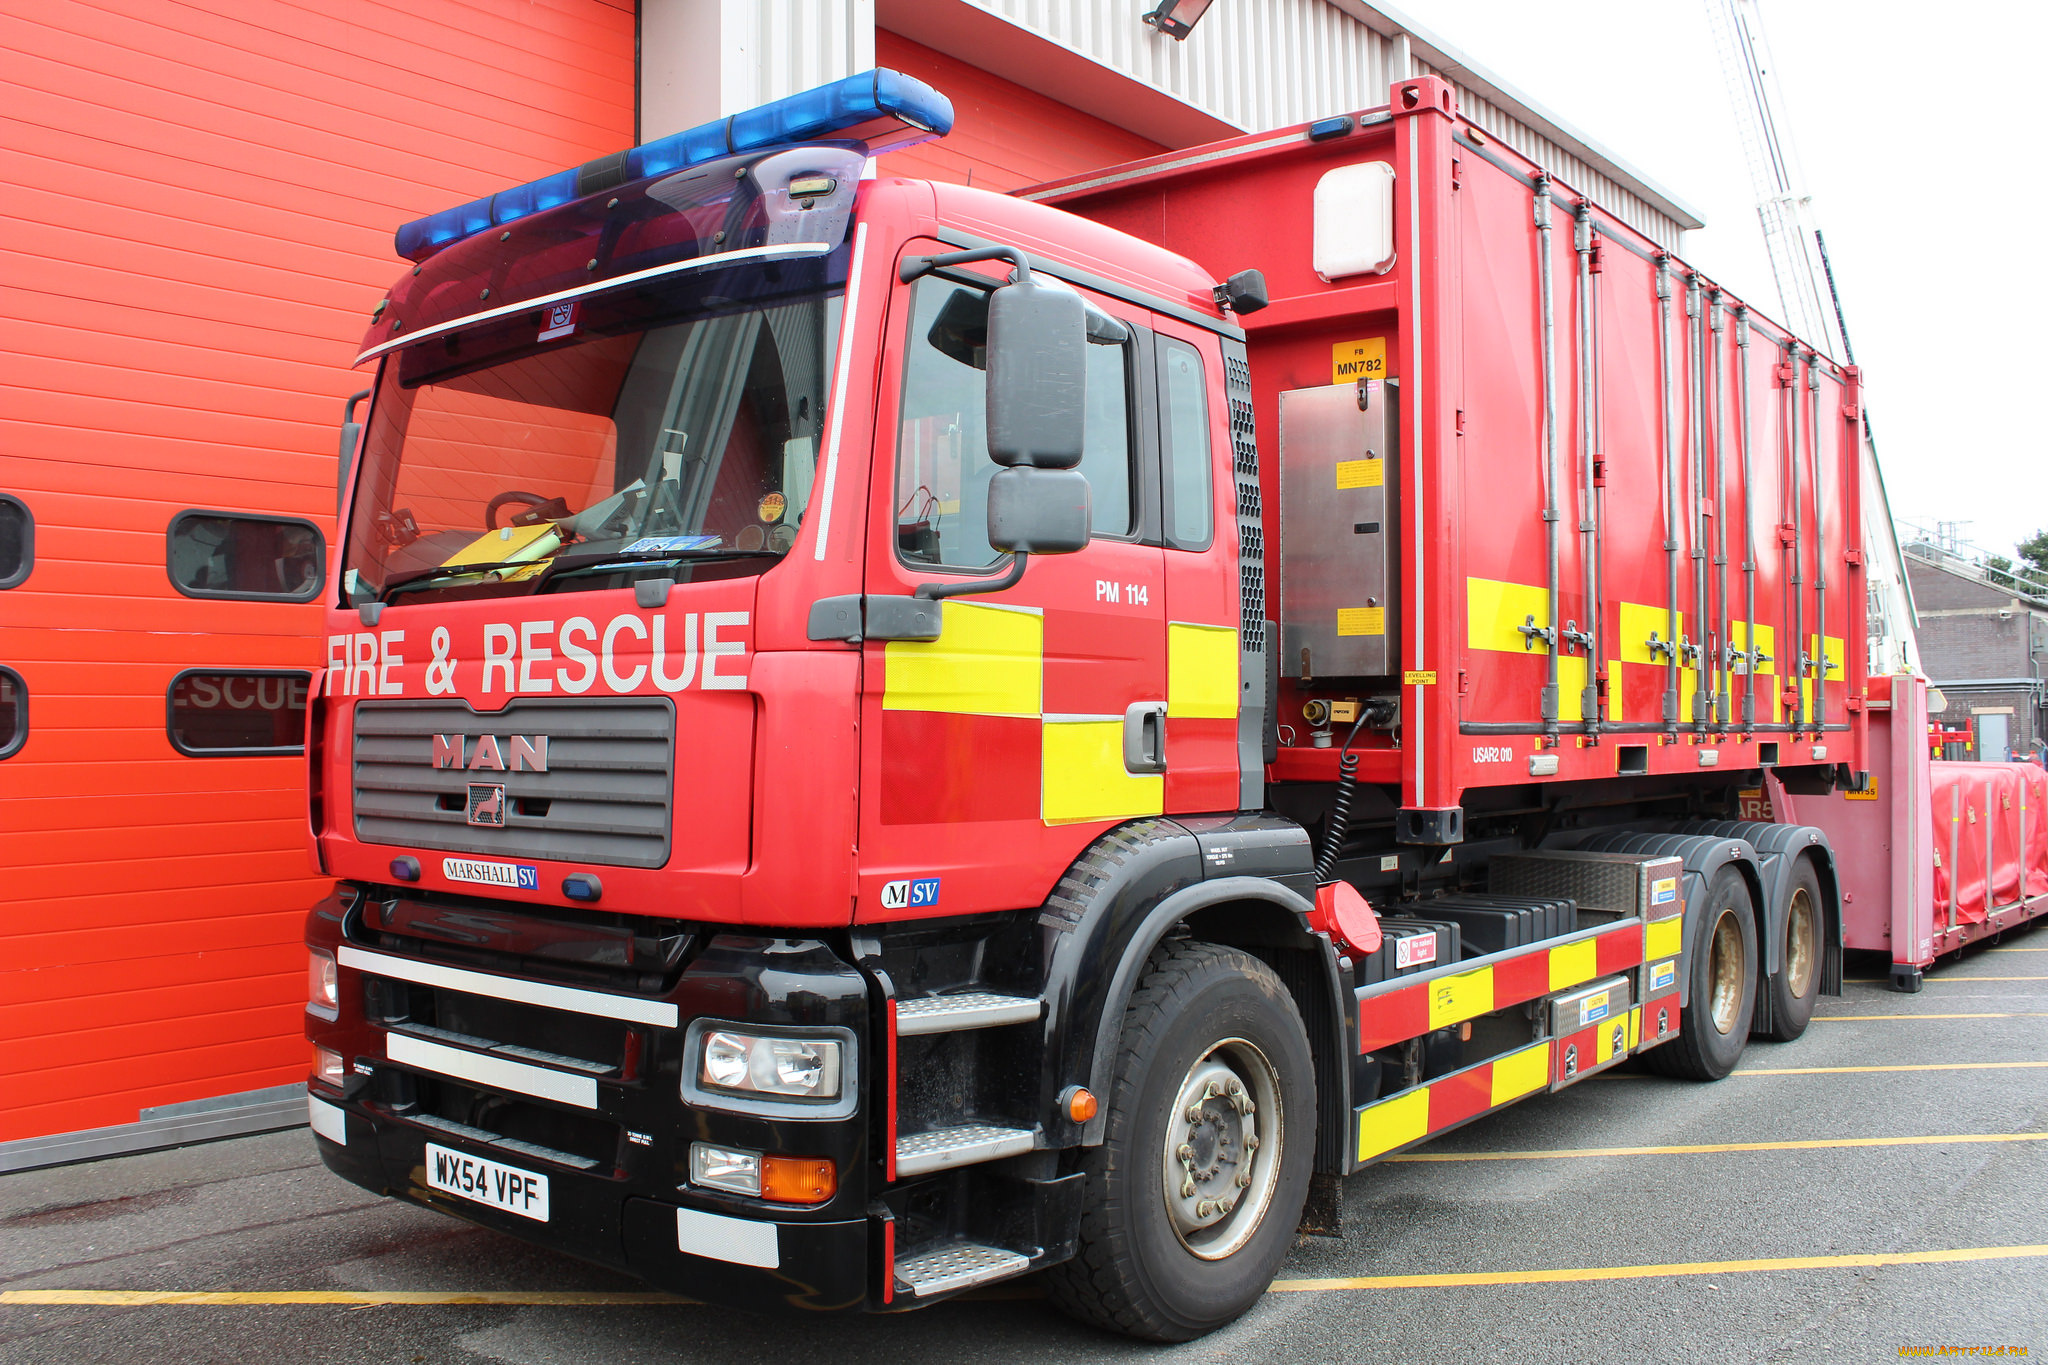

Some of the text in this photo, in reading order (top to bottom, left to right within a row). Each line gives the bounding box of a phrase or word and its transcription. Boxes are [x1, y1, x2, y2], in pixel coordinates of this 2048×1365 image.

[1354, 348, 1364, 356] FB
[1337, 358, 1382, 375] MN782
[1095, 579, 1149, 606] PM 114
[325, 611, 750, 697] FIRE & RESCUE
[432, 734, 550, 773] MAN
[1472, 746, 1513, 763] USAR2 010
[446, 861, 537, 886] MARSHALL SV
[887, 882, 938, 904] M SV
[1411, 937, 1433, 948] No naked
[1417, 947, 1428, 958] light
[436, 1151, 538, 1210] WX54 VPF
